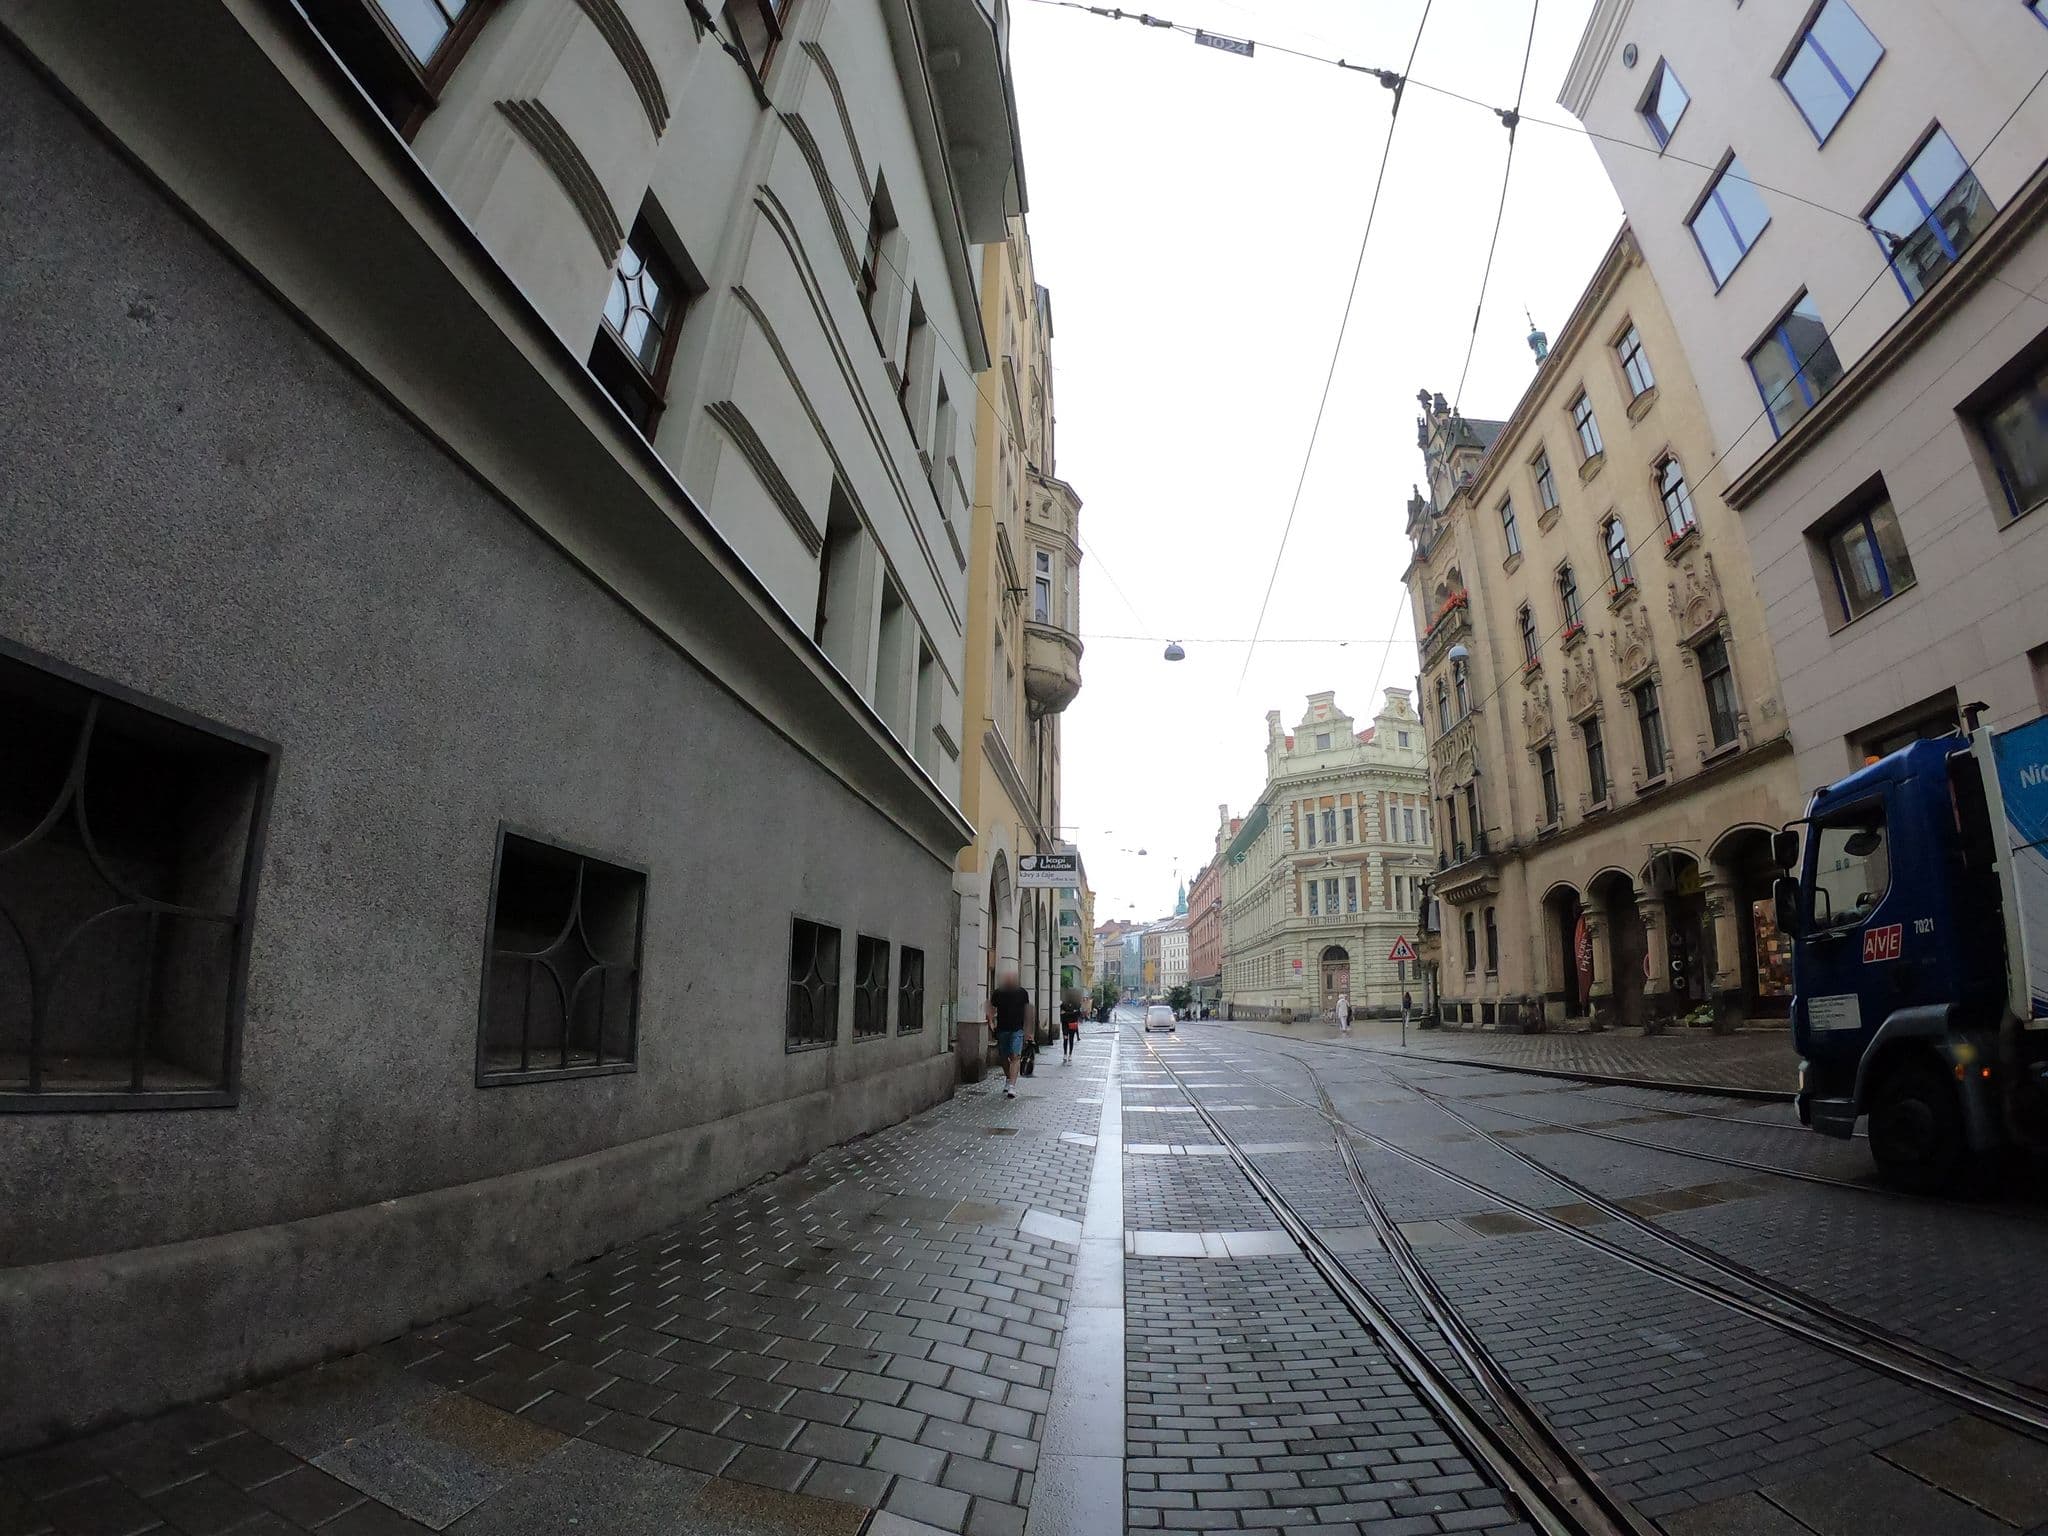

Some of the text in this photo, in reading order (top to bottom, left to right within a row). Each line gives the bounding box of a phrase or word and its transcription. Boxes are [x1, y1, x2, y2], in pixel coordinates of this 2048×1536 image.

[1204, 36, 1249, 55] 1024
[1046, 855, 1066, 864] kopi
[1913, 917, 1935, 934] 7021
[1864, 933, 1898, 954] AVE
